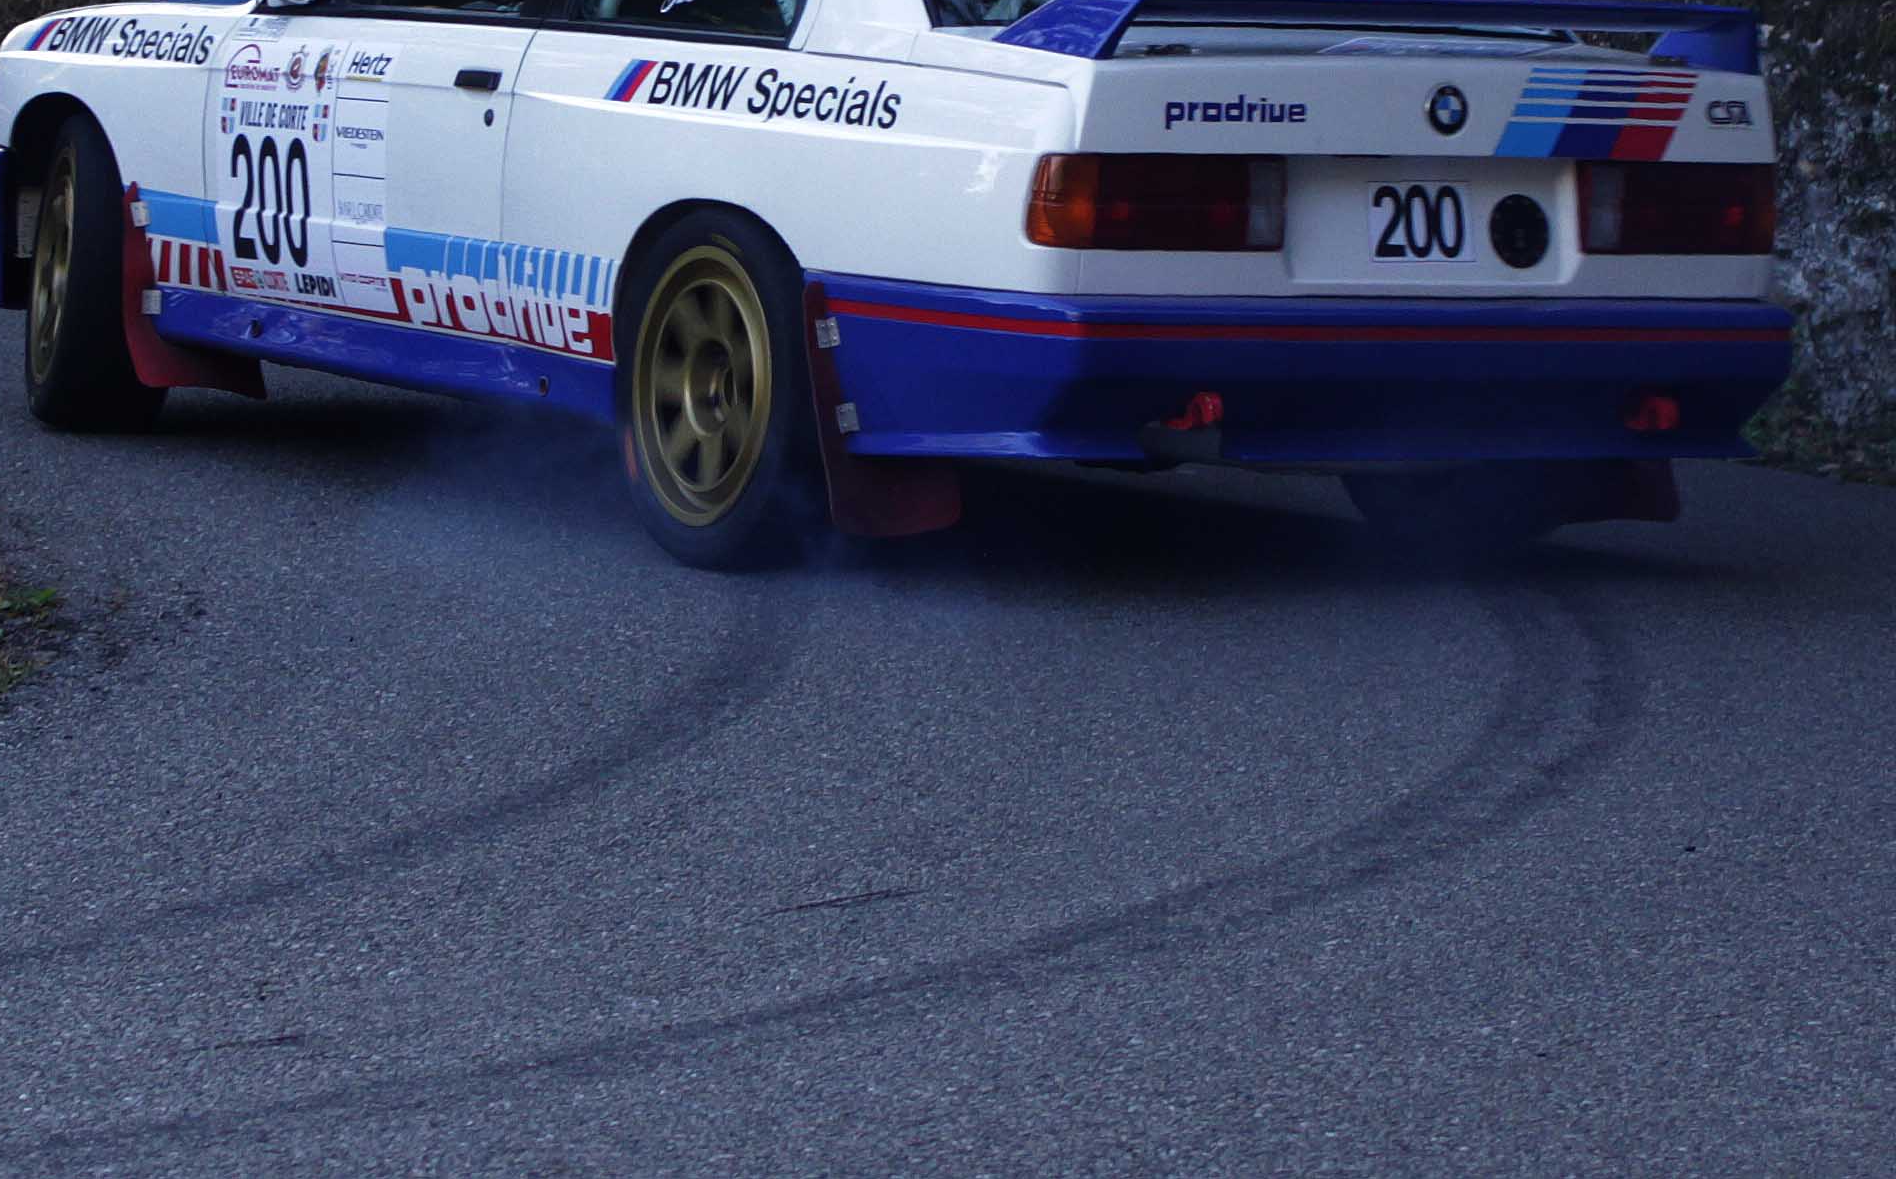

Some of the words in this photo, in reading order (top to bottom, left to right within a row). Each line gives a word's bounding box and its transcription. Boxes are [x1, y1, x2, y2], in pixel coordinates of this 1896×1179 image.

[48, 16, 120, 54] BMW
[112, 18, 214, 66] Specials
[347, 50, 393, 77] Hertz
[239, 100, 266, 127] VILLE
[264, 102, 278, 129] DE
[278, 104, 309, 131] CORTE
[648, 60, 750, 111] BMW
[747, 67, 902, 130] Specials
[230, 133, 311, 268] 200
[1373, 183, 1466, 259] 200
[293, 272, 337, 299] LEPIDI
